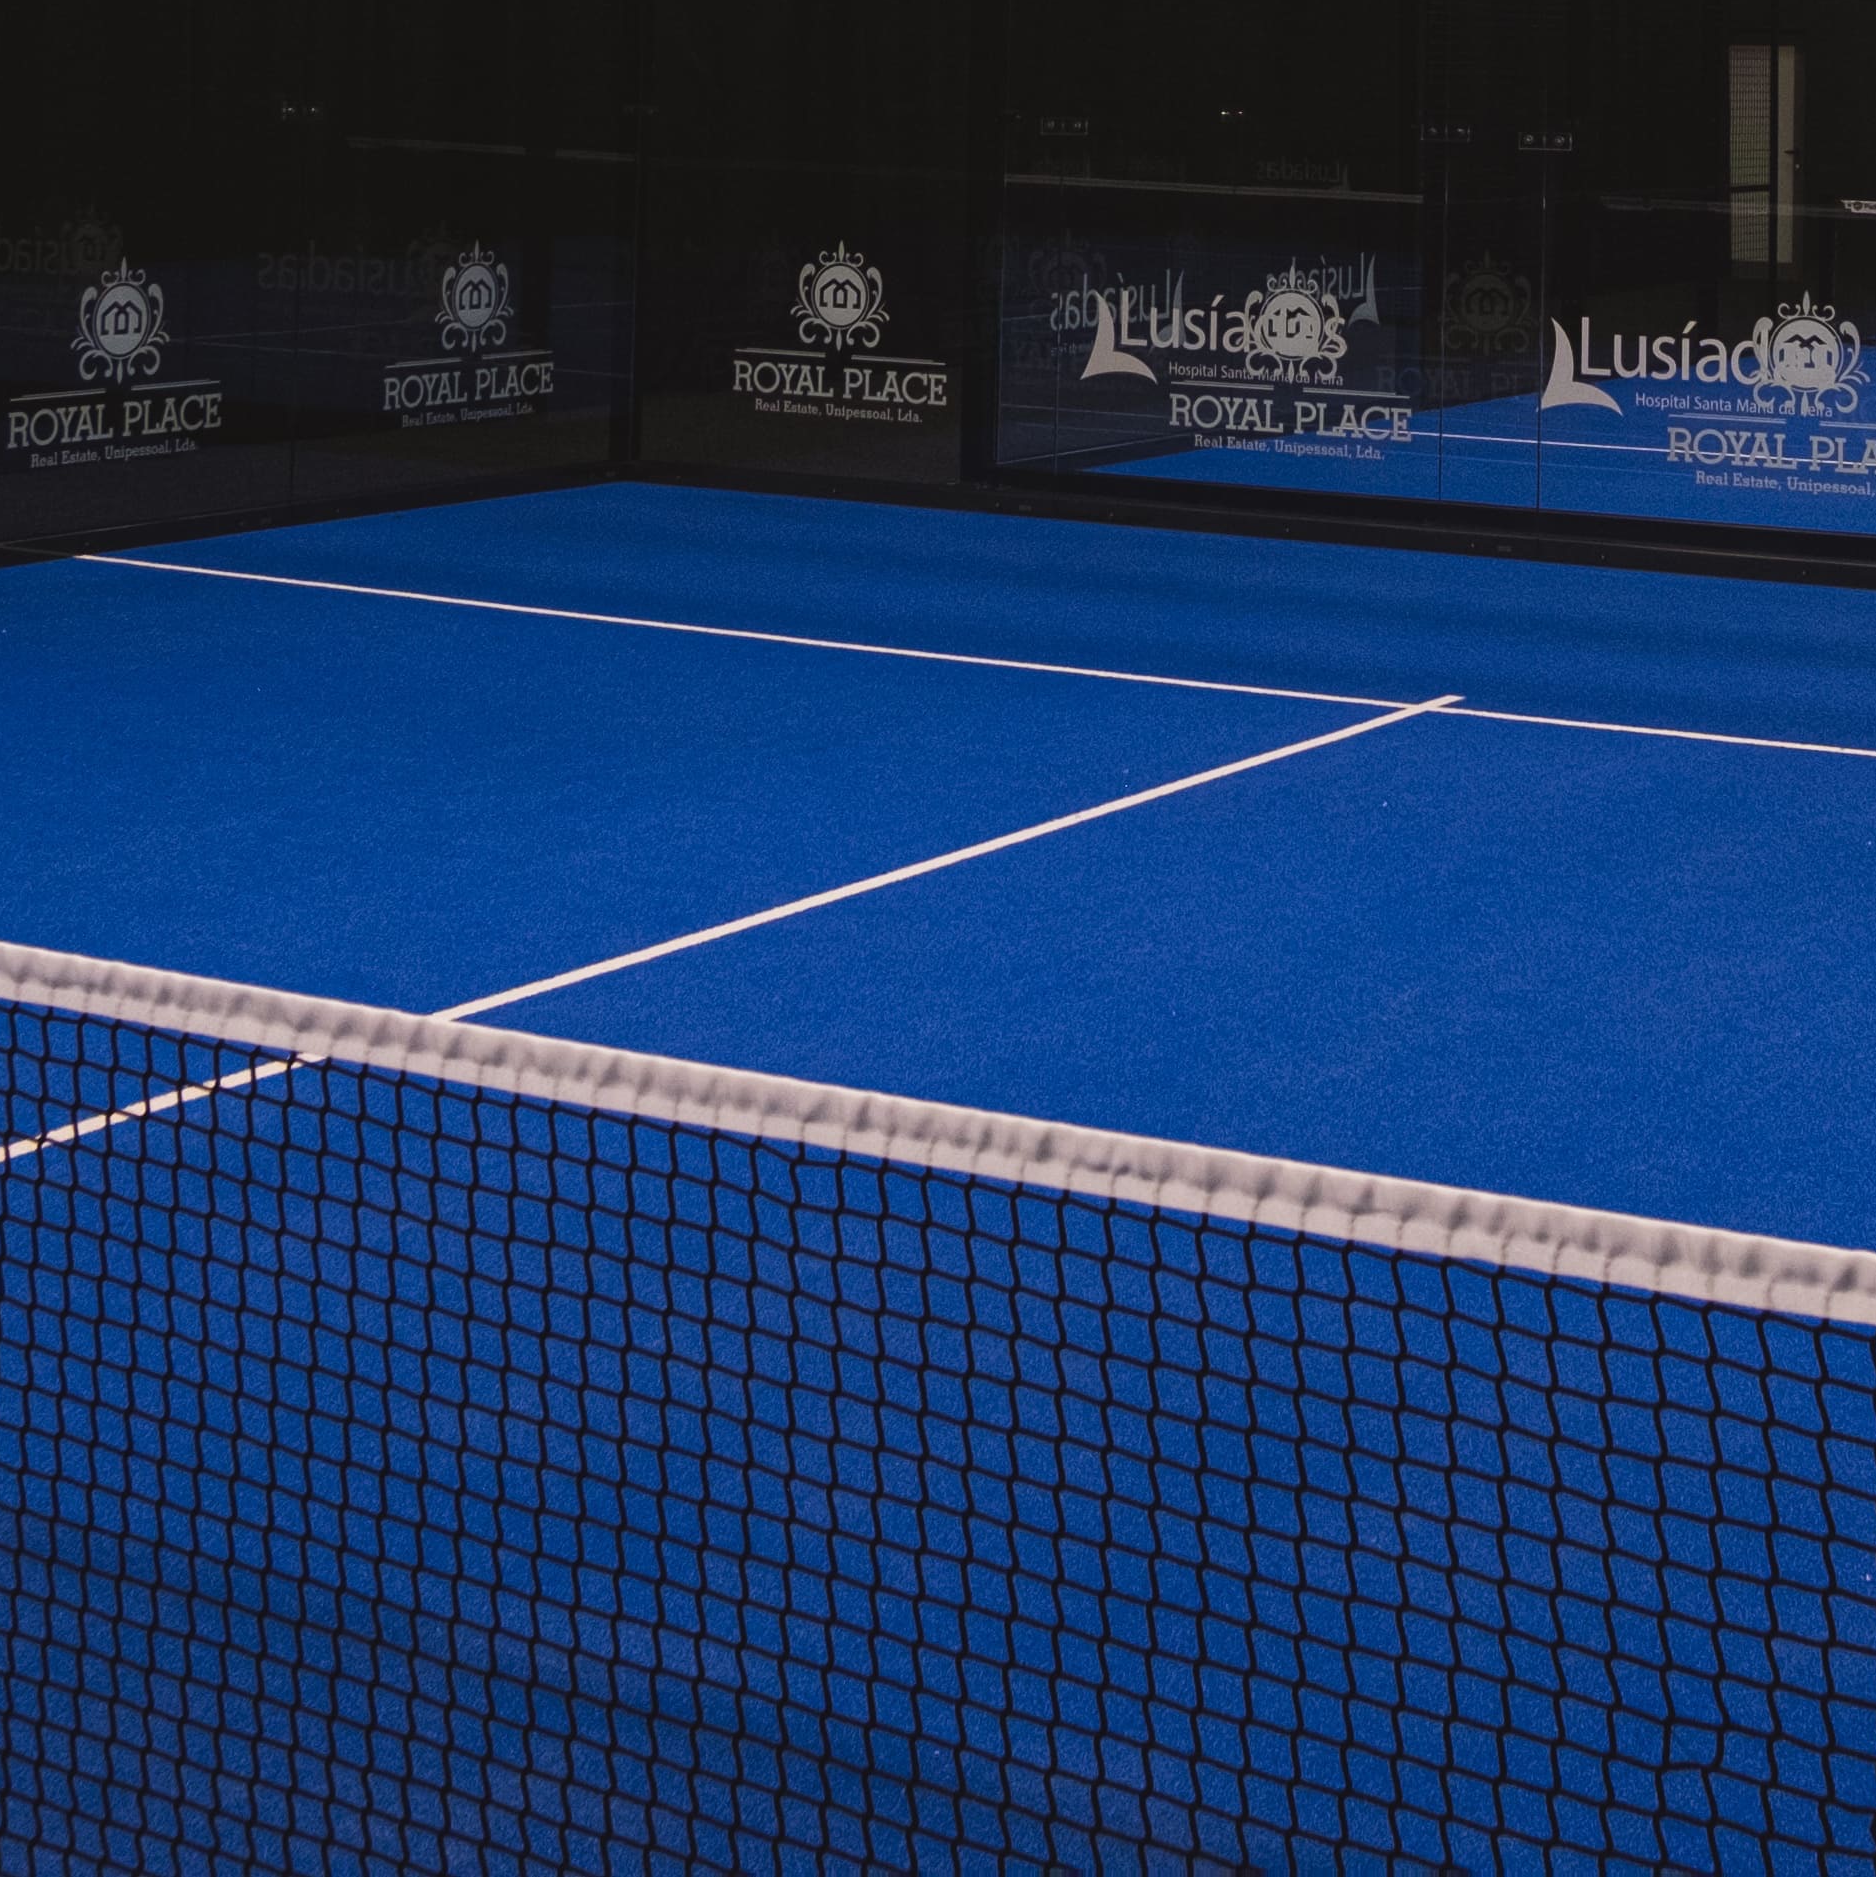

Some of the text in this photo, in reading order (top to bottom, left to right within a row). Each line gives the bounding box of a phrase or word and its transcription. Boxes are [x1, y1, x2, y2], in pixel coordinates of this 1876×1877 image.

[1580, 316, 1823, 386] Lusíad
[382, 361, 555, 411] ROYAL PLACE
[732, 360, 948, 407] ROYAL PLACE
[754, 397, 781, 413] Real
[1635, 391, 1690, 411] Hospital
[6, 392, 223, 450] ROYAL PLACE
[1169, 393, 1413, 443] ROYAL PLACE
[1194, 433, 1224, 449] Real
[1666, 426, 1798, 471] ROYAL
[1695, 468, 1729, 486] Real
